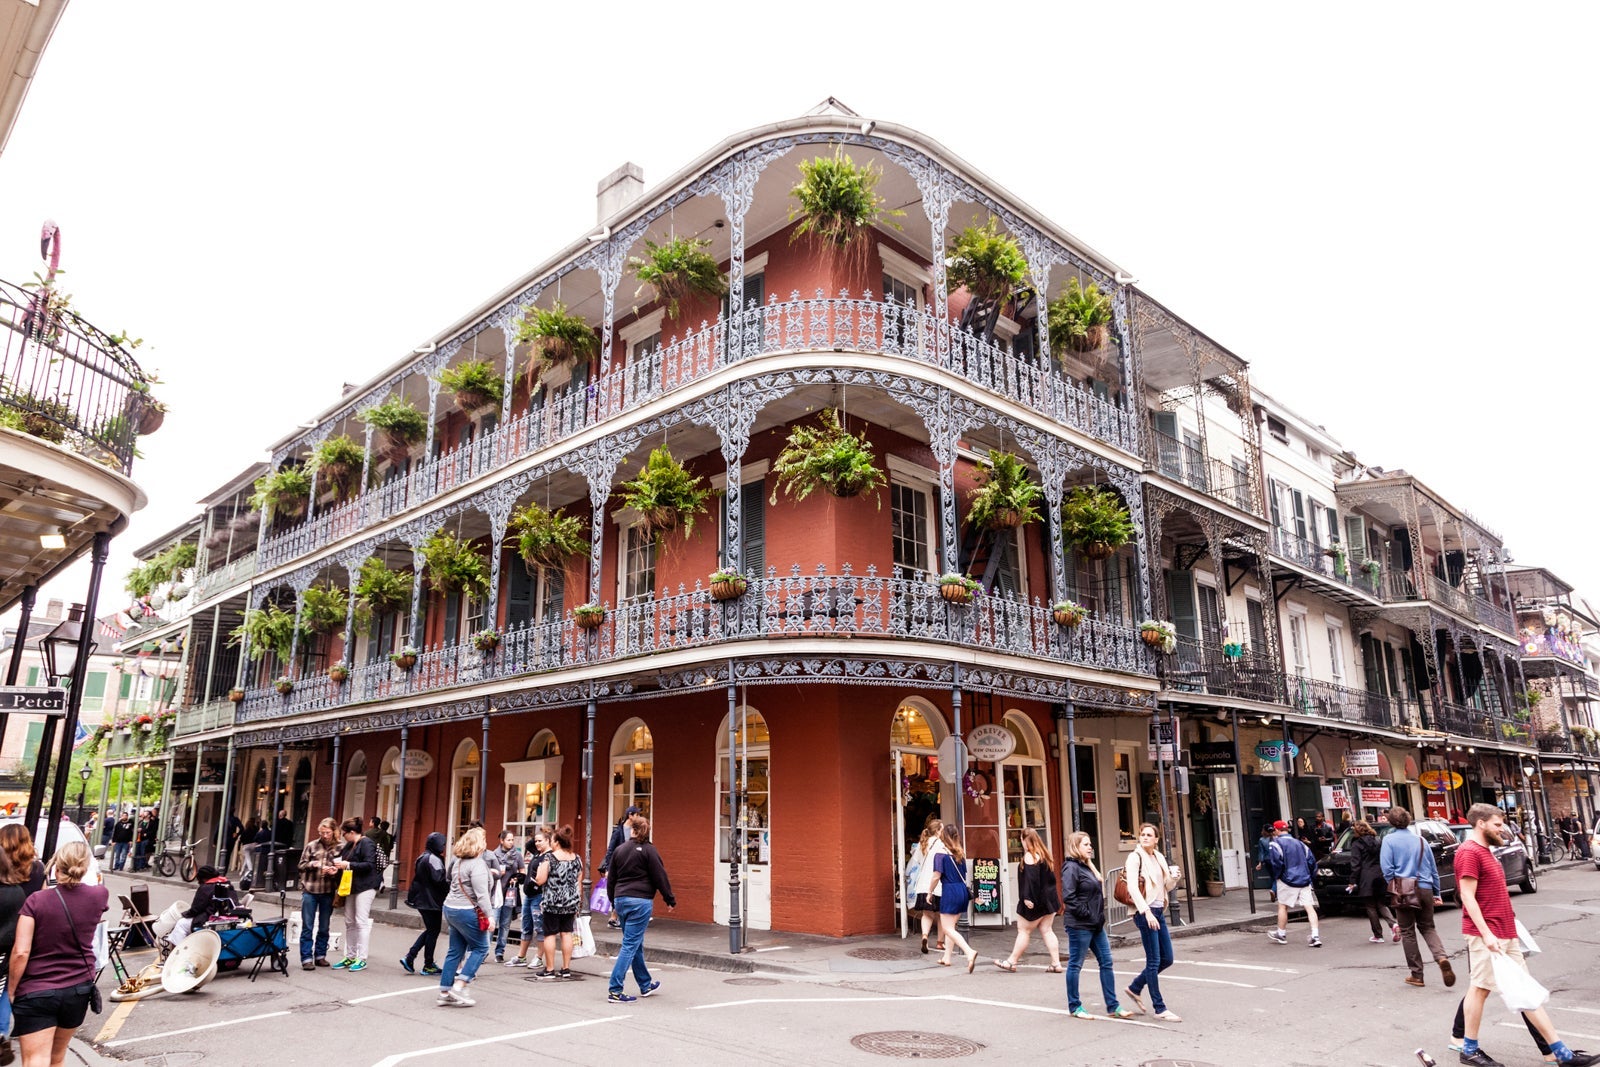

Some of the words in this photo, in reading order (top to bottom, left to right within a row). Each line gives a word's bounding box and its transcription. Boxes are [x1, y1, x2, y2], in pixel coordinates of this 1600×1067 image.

[13, 695, 61, 707] Peter
[973, 728, 1007, 740] FOREVER
[974, 865, 999, 873] FOREVER
